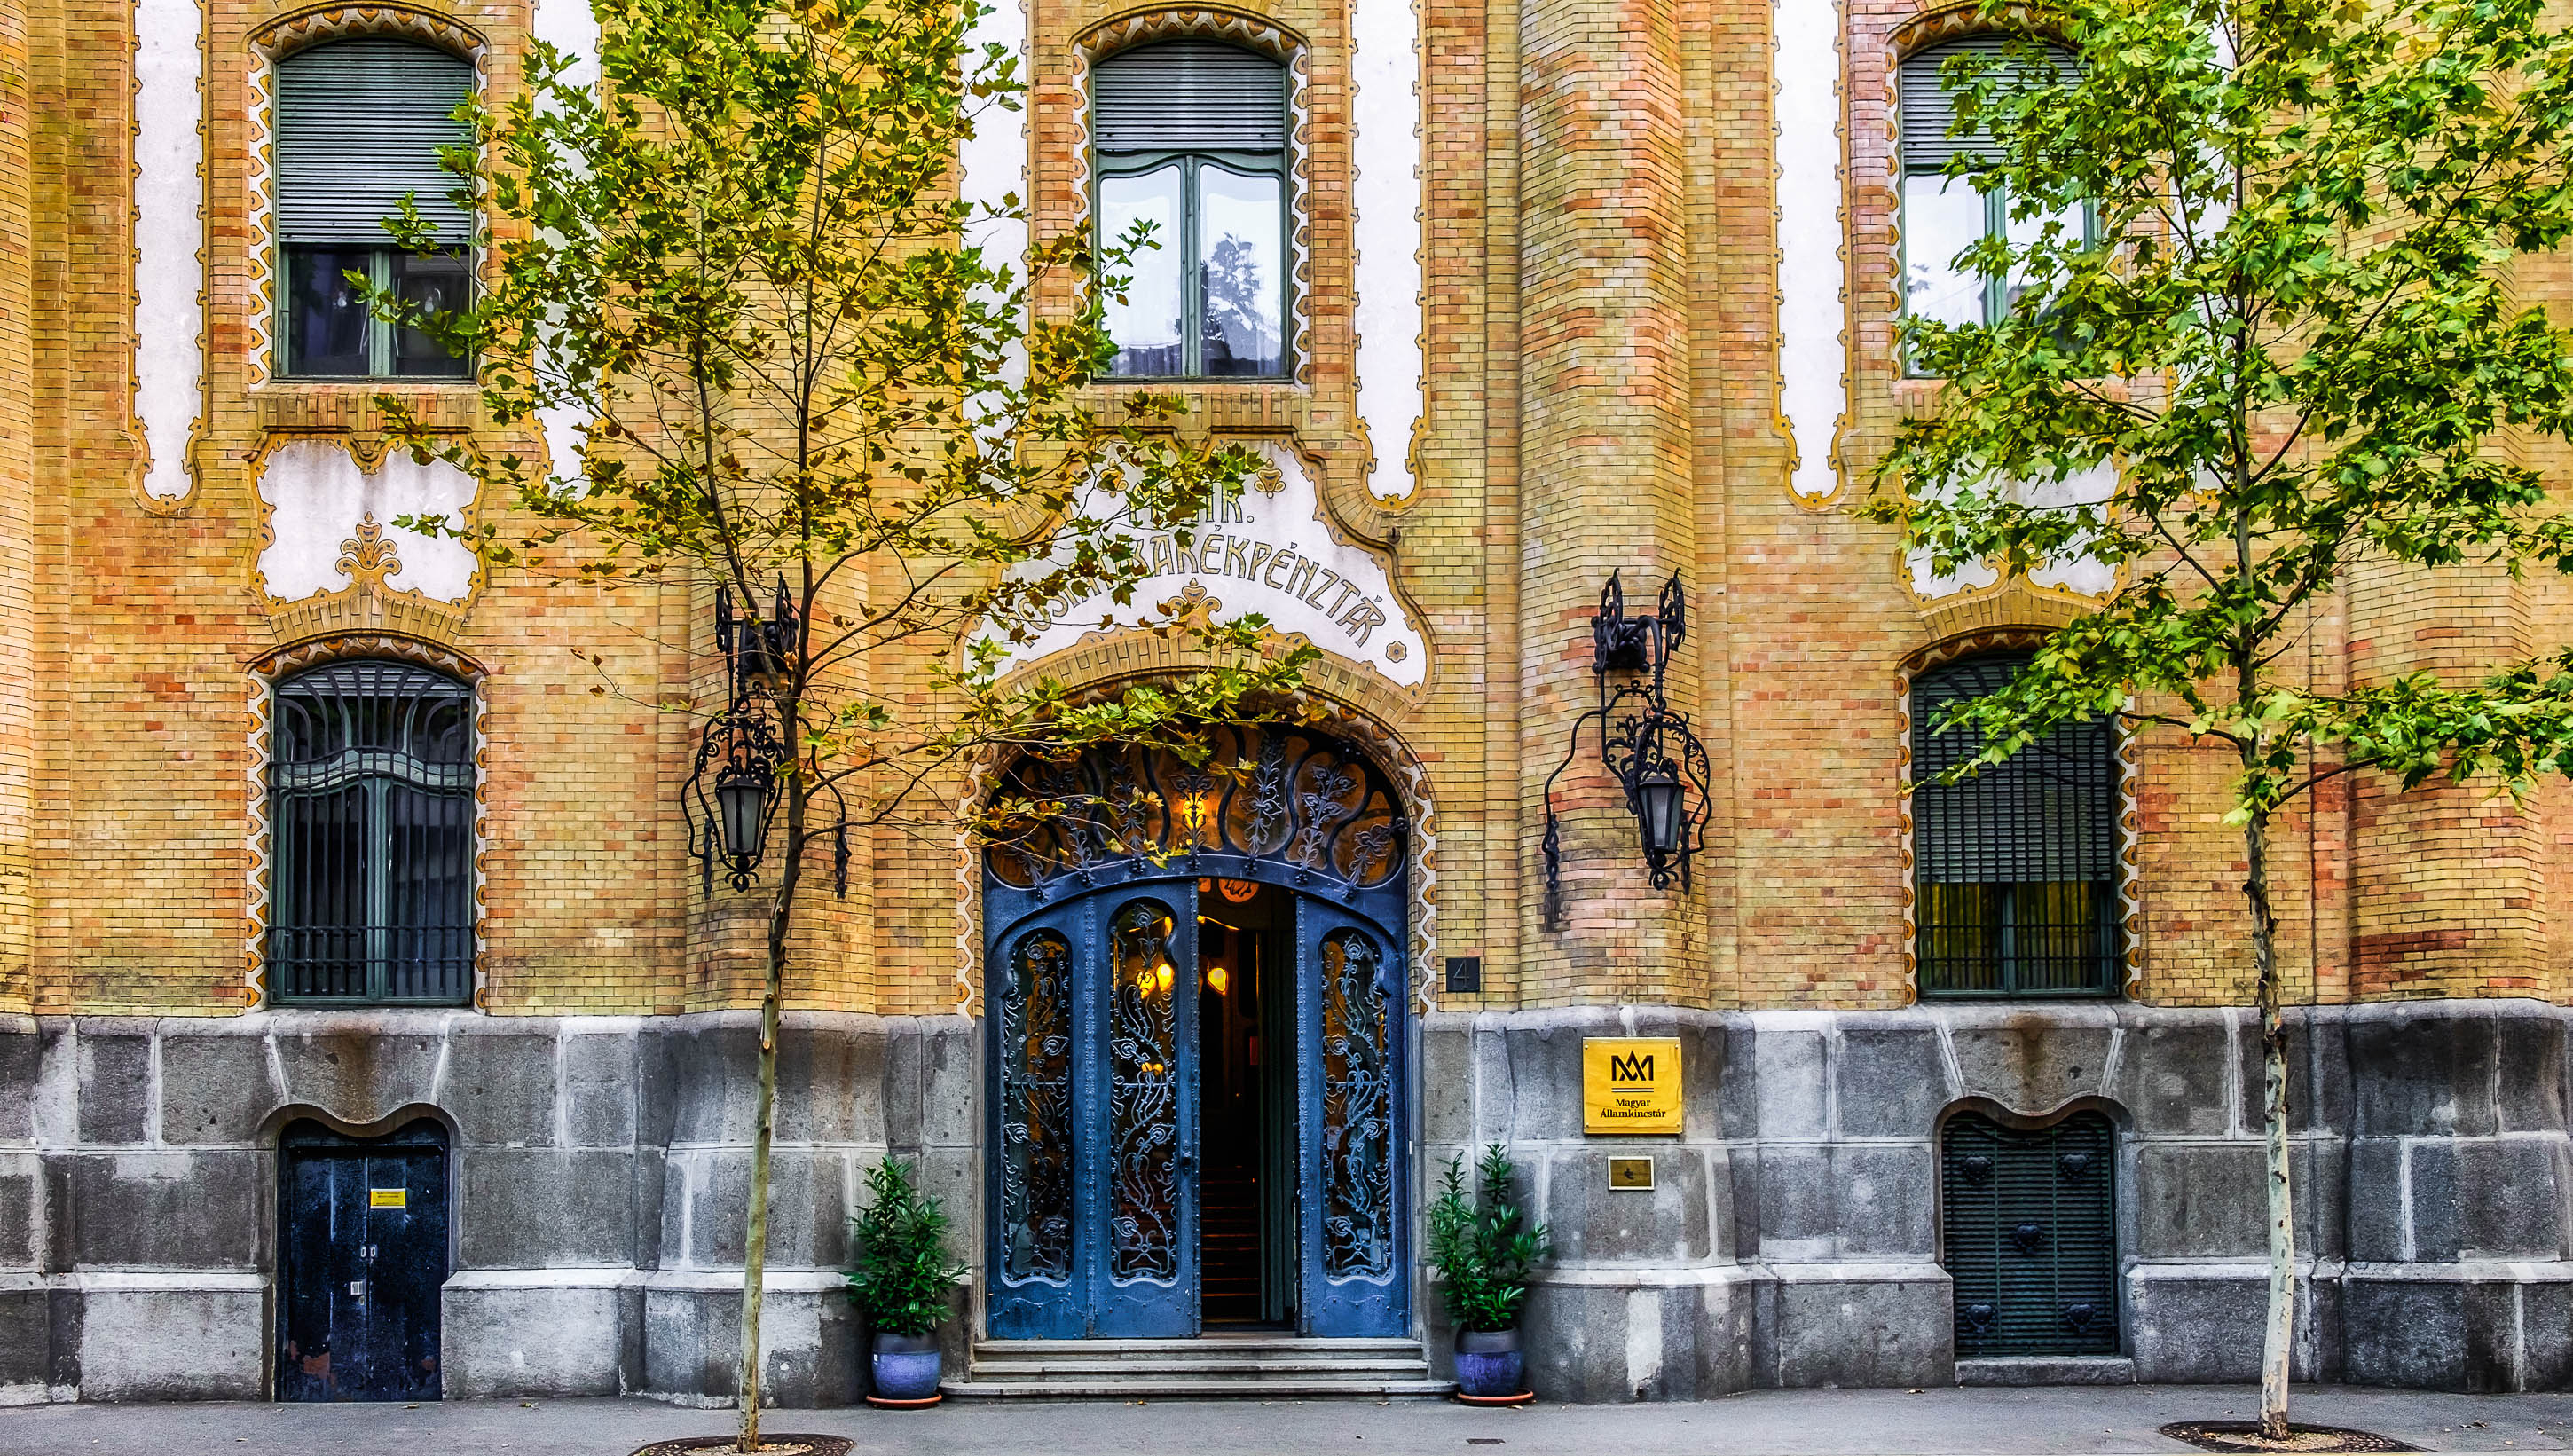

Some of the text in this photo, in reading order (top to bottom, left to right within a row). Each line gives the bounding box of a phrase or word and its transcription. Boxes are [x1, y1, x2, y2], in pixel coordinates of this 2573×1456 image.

[1452, 959, 1470, 988] 4
[1615, 1098, 1651, 1109] Magyar
[1600, 1108, 1667, 1119] Államkincstár
